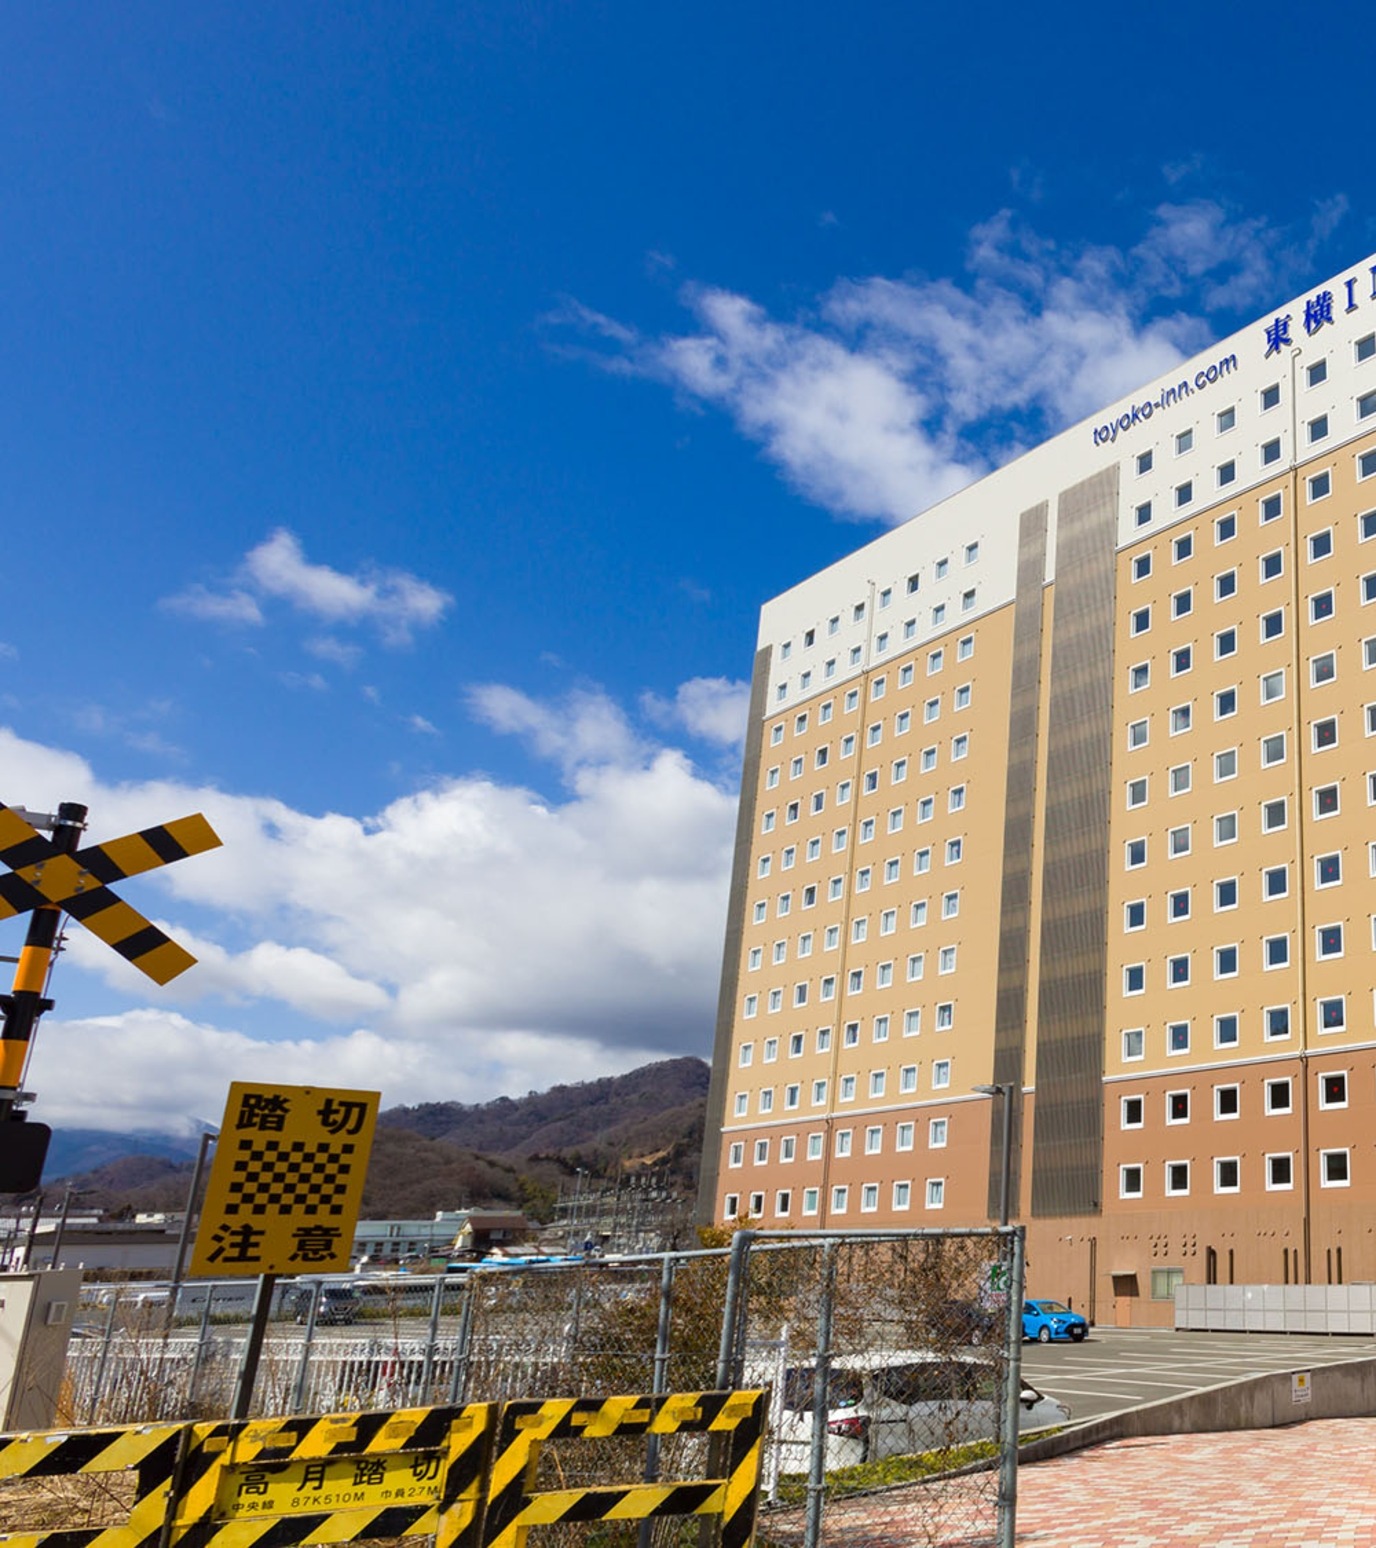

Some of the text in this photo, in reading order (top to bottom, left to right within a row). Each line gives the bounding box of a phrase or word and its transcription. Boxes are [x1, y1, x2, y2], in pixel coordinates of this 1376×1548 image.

[1092, 351, 1238, 447] toyoko-inn.com
[235, 1093, 368, 1135] 踏切
[206, 1223, 342, 1264] 注意
[237, 1455, 441, 1498] 高月踏切
[232, 1499, 275, 1512] 中央線
[290, 1491, 366, 1508] 87K510M
